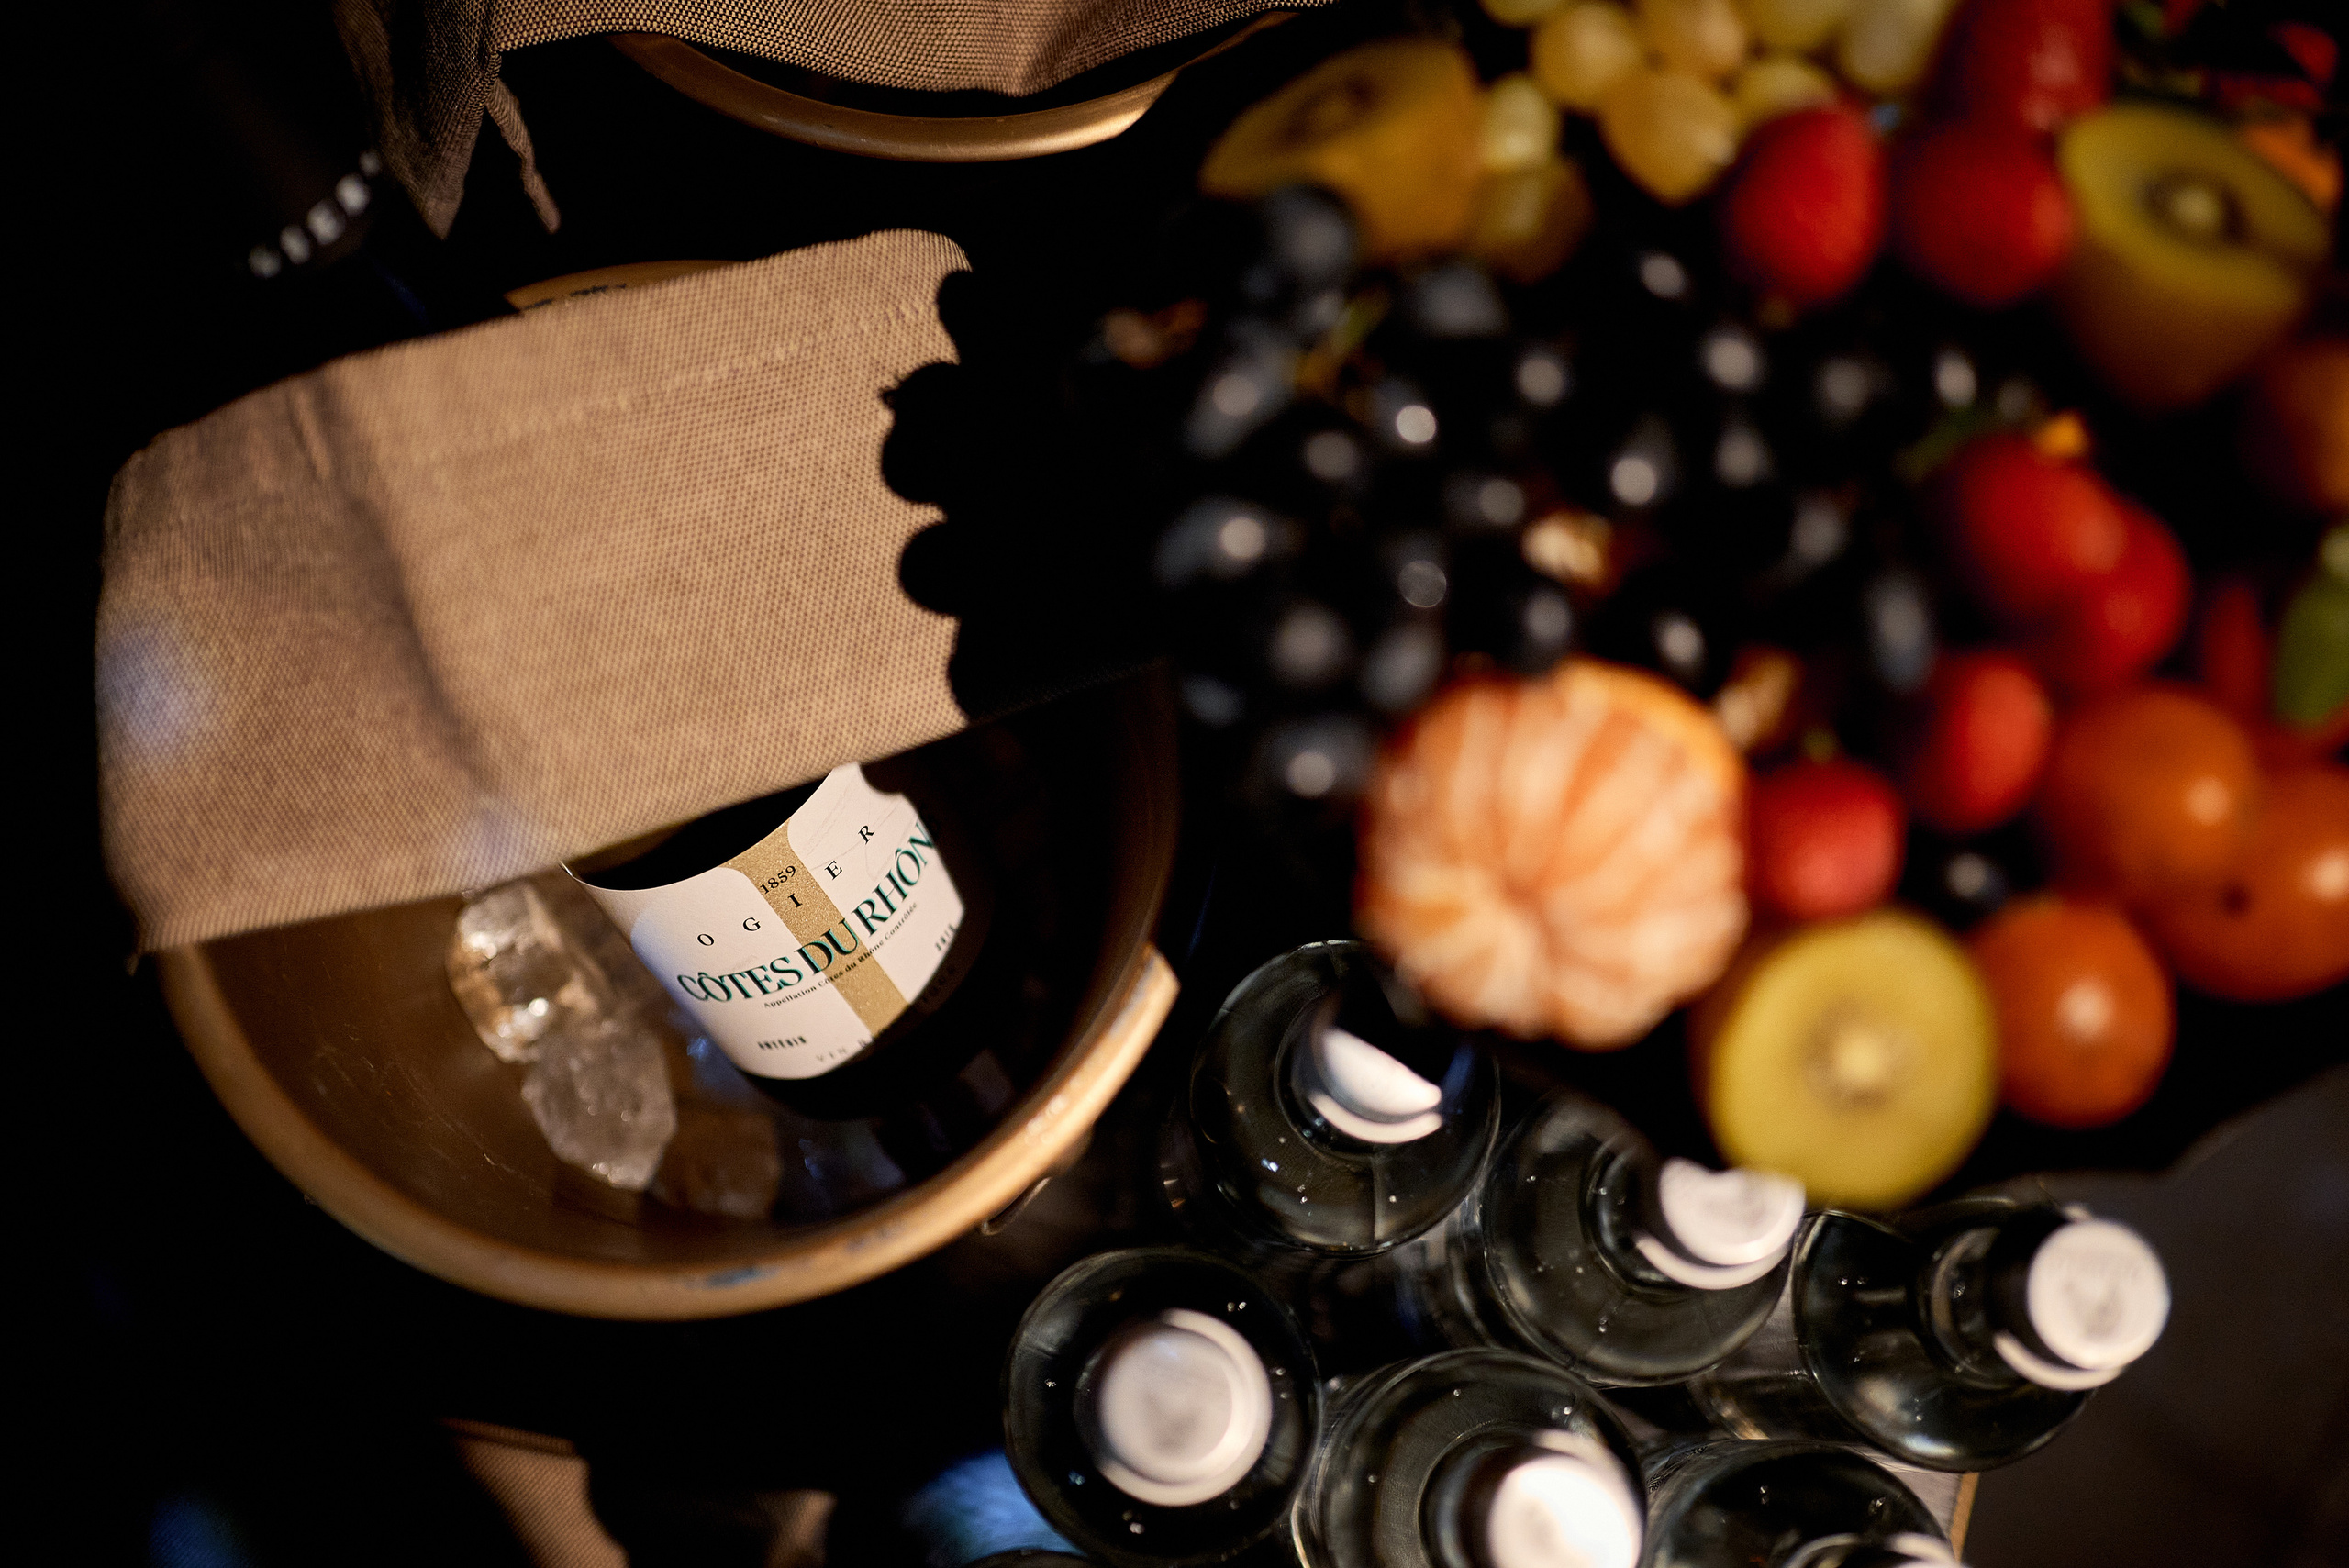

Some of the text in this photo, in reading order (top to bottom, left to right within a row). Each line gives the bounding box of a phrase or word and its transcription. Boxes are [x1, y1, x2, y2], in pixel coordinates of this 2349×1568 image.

[676, 818, 938, 1004] CÔTES DU RHÔN
[760, 864, 796, 895] 1859
[763, 902, 918, 1009] Appellation Côtes du Rhône Contrôlée
